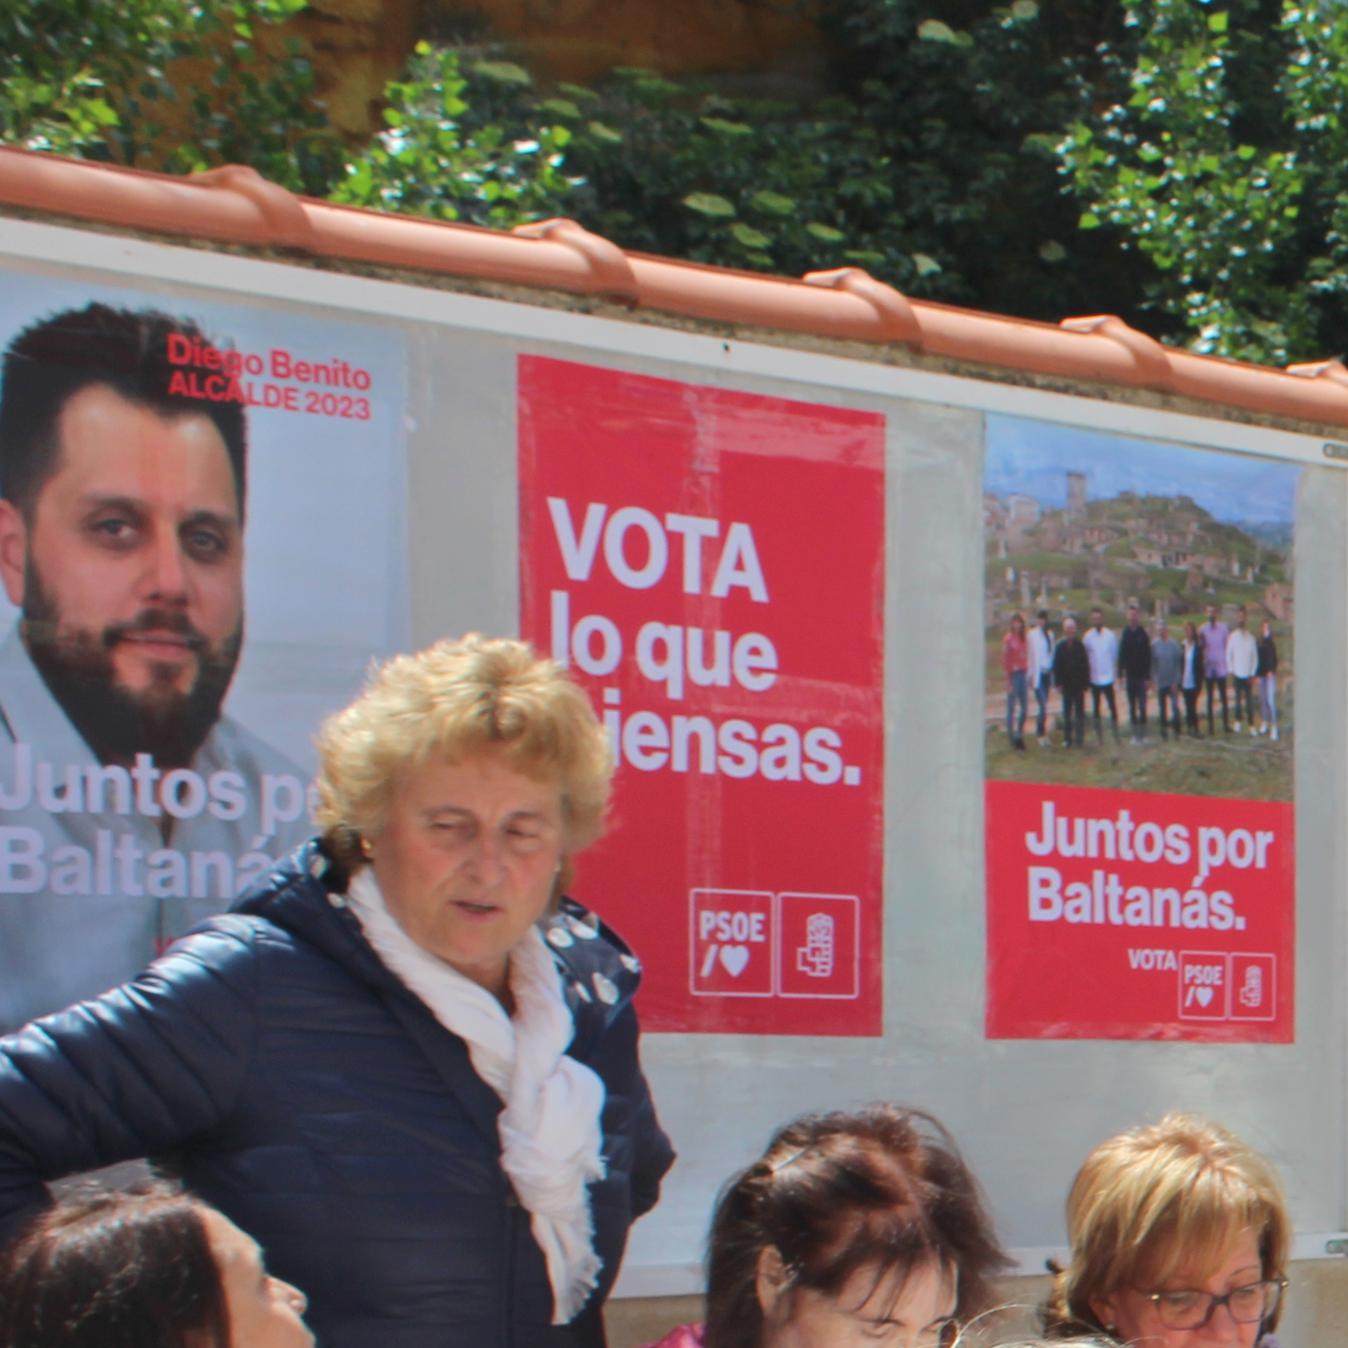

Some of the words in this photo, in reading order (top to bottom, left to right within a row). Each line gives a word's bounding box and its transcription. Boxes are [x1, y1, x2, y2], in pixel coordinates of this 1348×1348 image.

[165, 333, 264, 378] Diego
[270, 349, 372, 391] Benito
[167, 370, 300, 411] ALCALDE
[305, 390, 372, 421] 2023
[546, 496, 770, 604] VOTA
[551, 589, 622, 676] lo
[635, 620, 779, 700] que
[603, 687, 861, 786] iensas.
[0, 742, 247, 821] Juntos
[0, 826, 280, 899] Baltaná
[1025, 800, 1191, 864] Juntos
[1198, 825, 1275, 877] por
[699, 910, 766, 942] PSOE
[1027, 865, 1247, 930] Baltanás.
[1127, 948, 1178, 970] VOTA
[1183, 964, 1223, 985] PSOE
